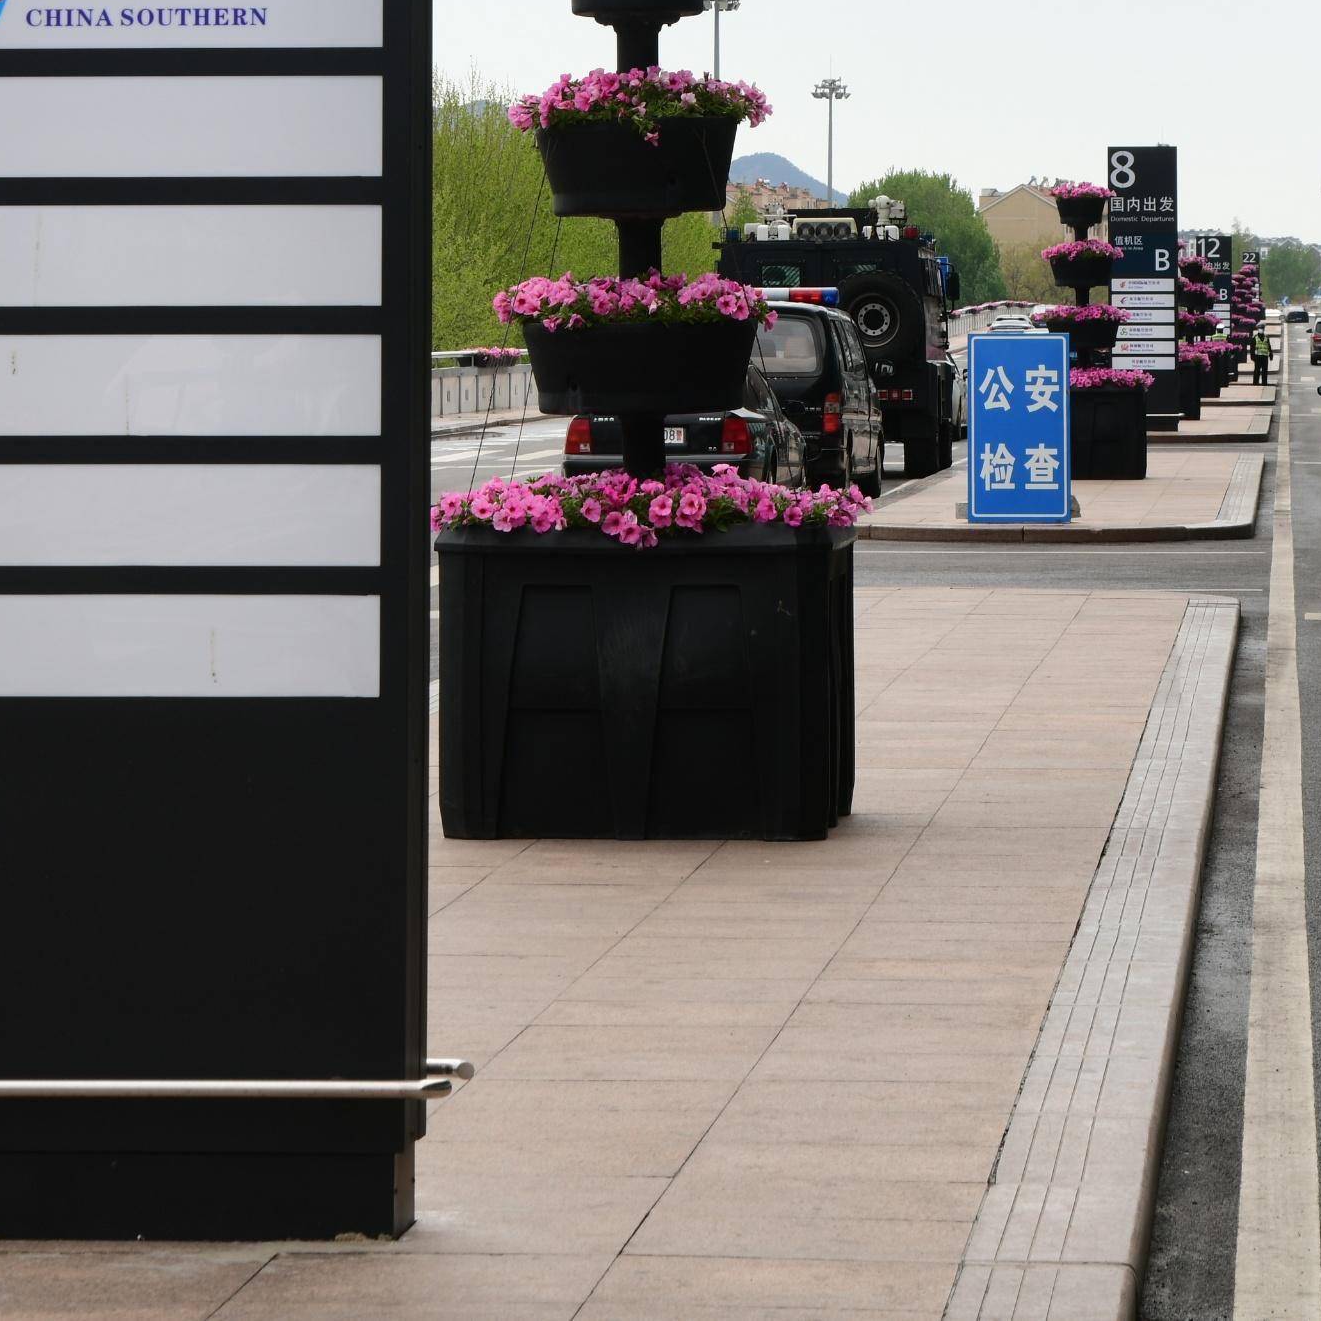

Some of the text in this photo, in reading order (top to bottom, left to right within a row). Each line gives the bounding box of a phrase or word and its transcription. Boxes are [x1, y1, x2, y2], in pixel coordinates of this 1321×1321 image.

[25, 7, 268, 28] CHINA SOUTHERN
[1110, 150, 1135, 188] 8
[1110, 196, 1174, 212] 国内出发
[1115, 236, 1143, 245] 值机区
[1198, 238, 1220, 257] 12
[1155, 248, 1170, 271] B
[1243, 253, 1256, 263] 22
[1219, 288, 1228, 300] B
[978, 364, 1060, 413] 公安
[979, 443, 1060, 491] 检查
